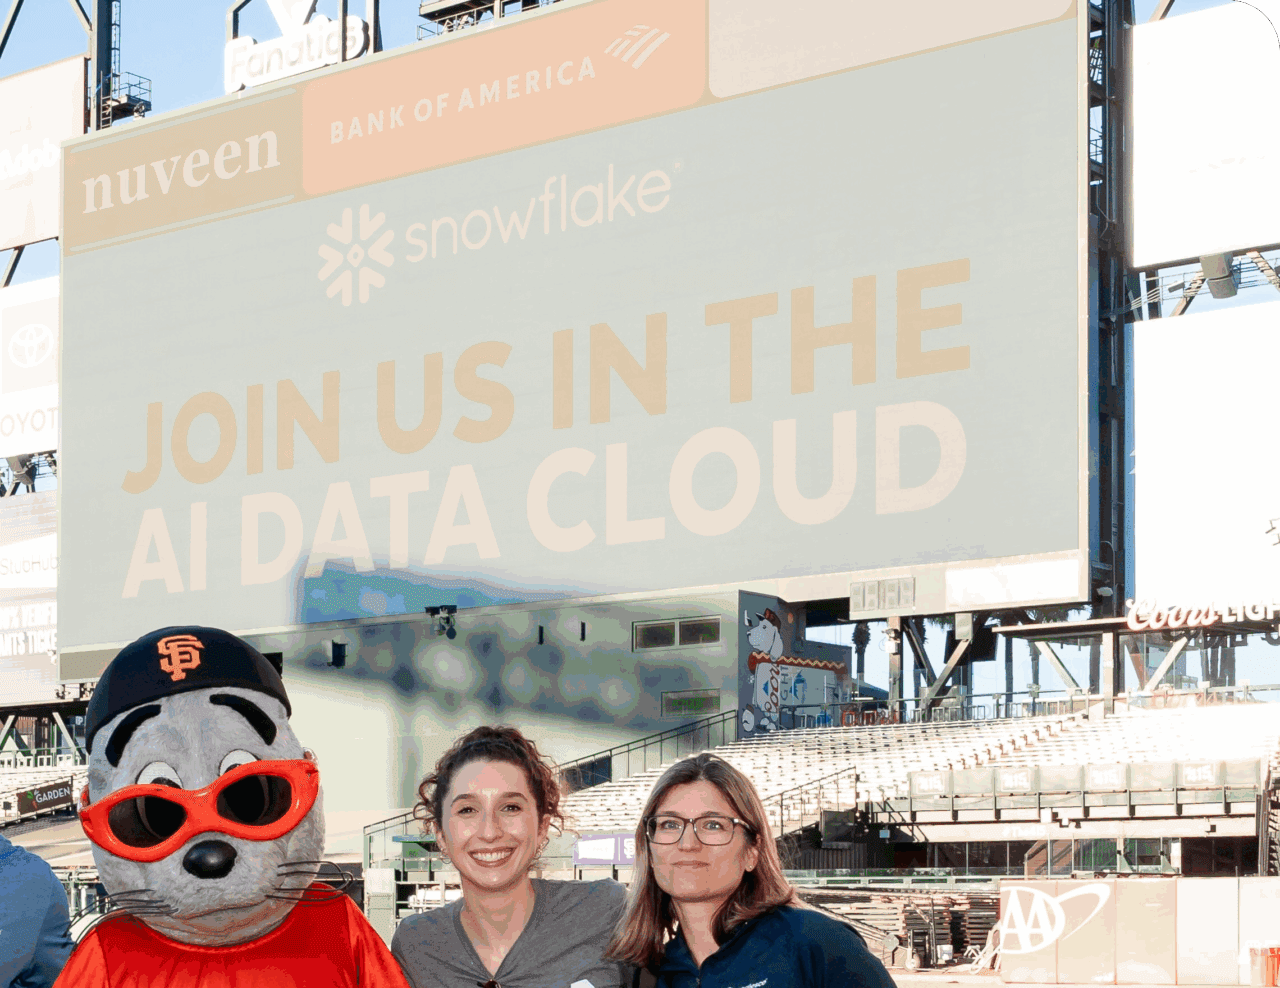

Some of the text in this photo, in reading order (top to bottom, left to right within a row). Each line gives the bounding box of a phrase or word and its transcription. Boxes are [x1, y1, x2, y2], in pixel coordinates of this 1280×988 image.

[228, 24, 358, 85] Fanatics
[329, 55, 597, 146] BANK OF AMERICA
[81, 128, 281, 215] nuveen
[404, 162, 673, 264] snowflake
[120, 257, 972, 495] JOIN US IN THE
[121, 399, 968, 599] AI DATA CLOUD
[27, 628, 57, 655] TICKE
[1125, 598, 1280, 631] Coors LIGH
[35, 786, 71, 803] GARDEN
